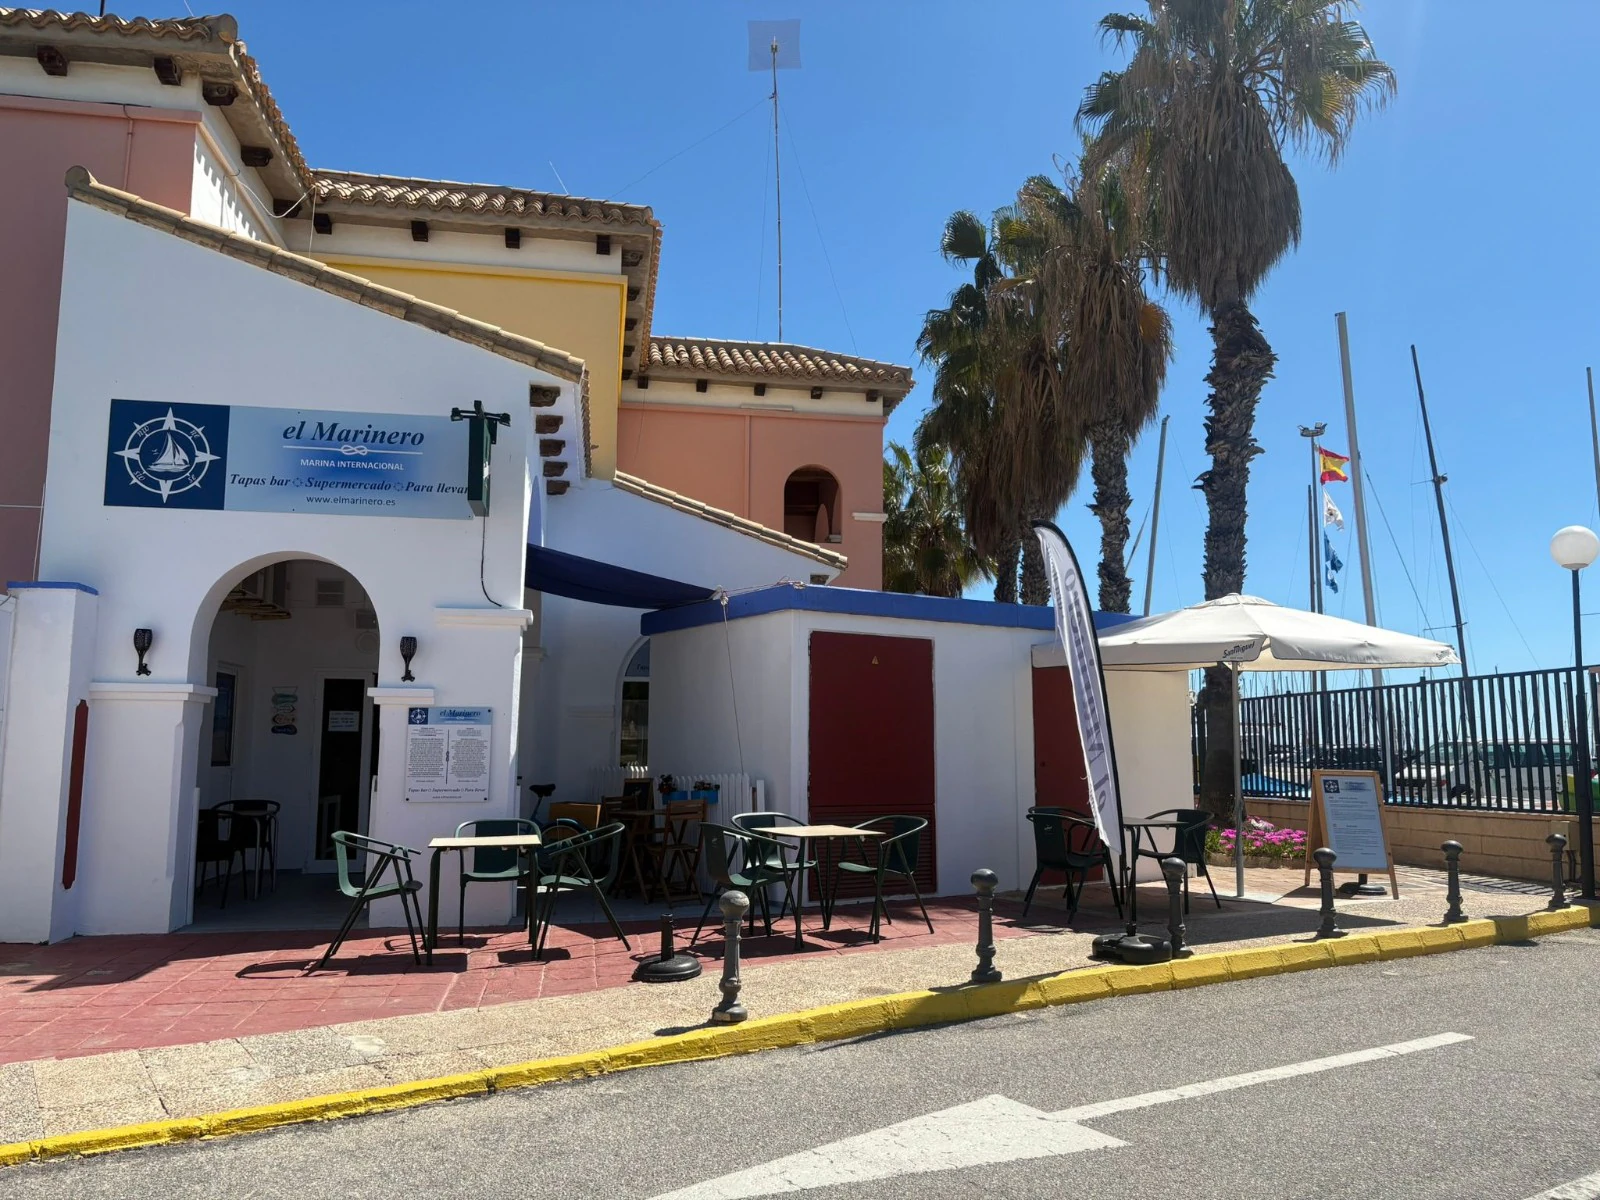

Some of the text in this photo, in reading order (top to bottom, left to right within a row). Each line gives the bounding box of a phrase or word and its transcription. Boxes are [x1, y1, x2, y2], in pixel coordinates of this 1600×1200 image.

[282, 420, 425, 446] el Marinero
[300, 458, 404, 471] MARINA INTERNACIONAL
[230, 474, 266, 488] Tapas
[270, 475, 291, 487] bar
[304, 477, 392, 492] Supermercado
[404, 481, 434, 494] Para
[306, 496, 396, 507] www.elmarinero.es
